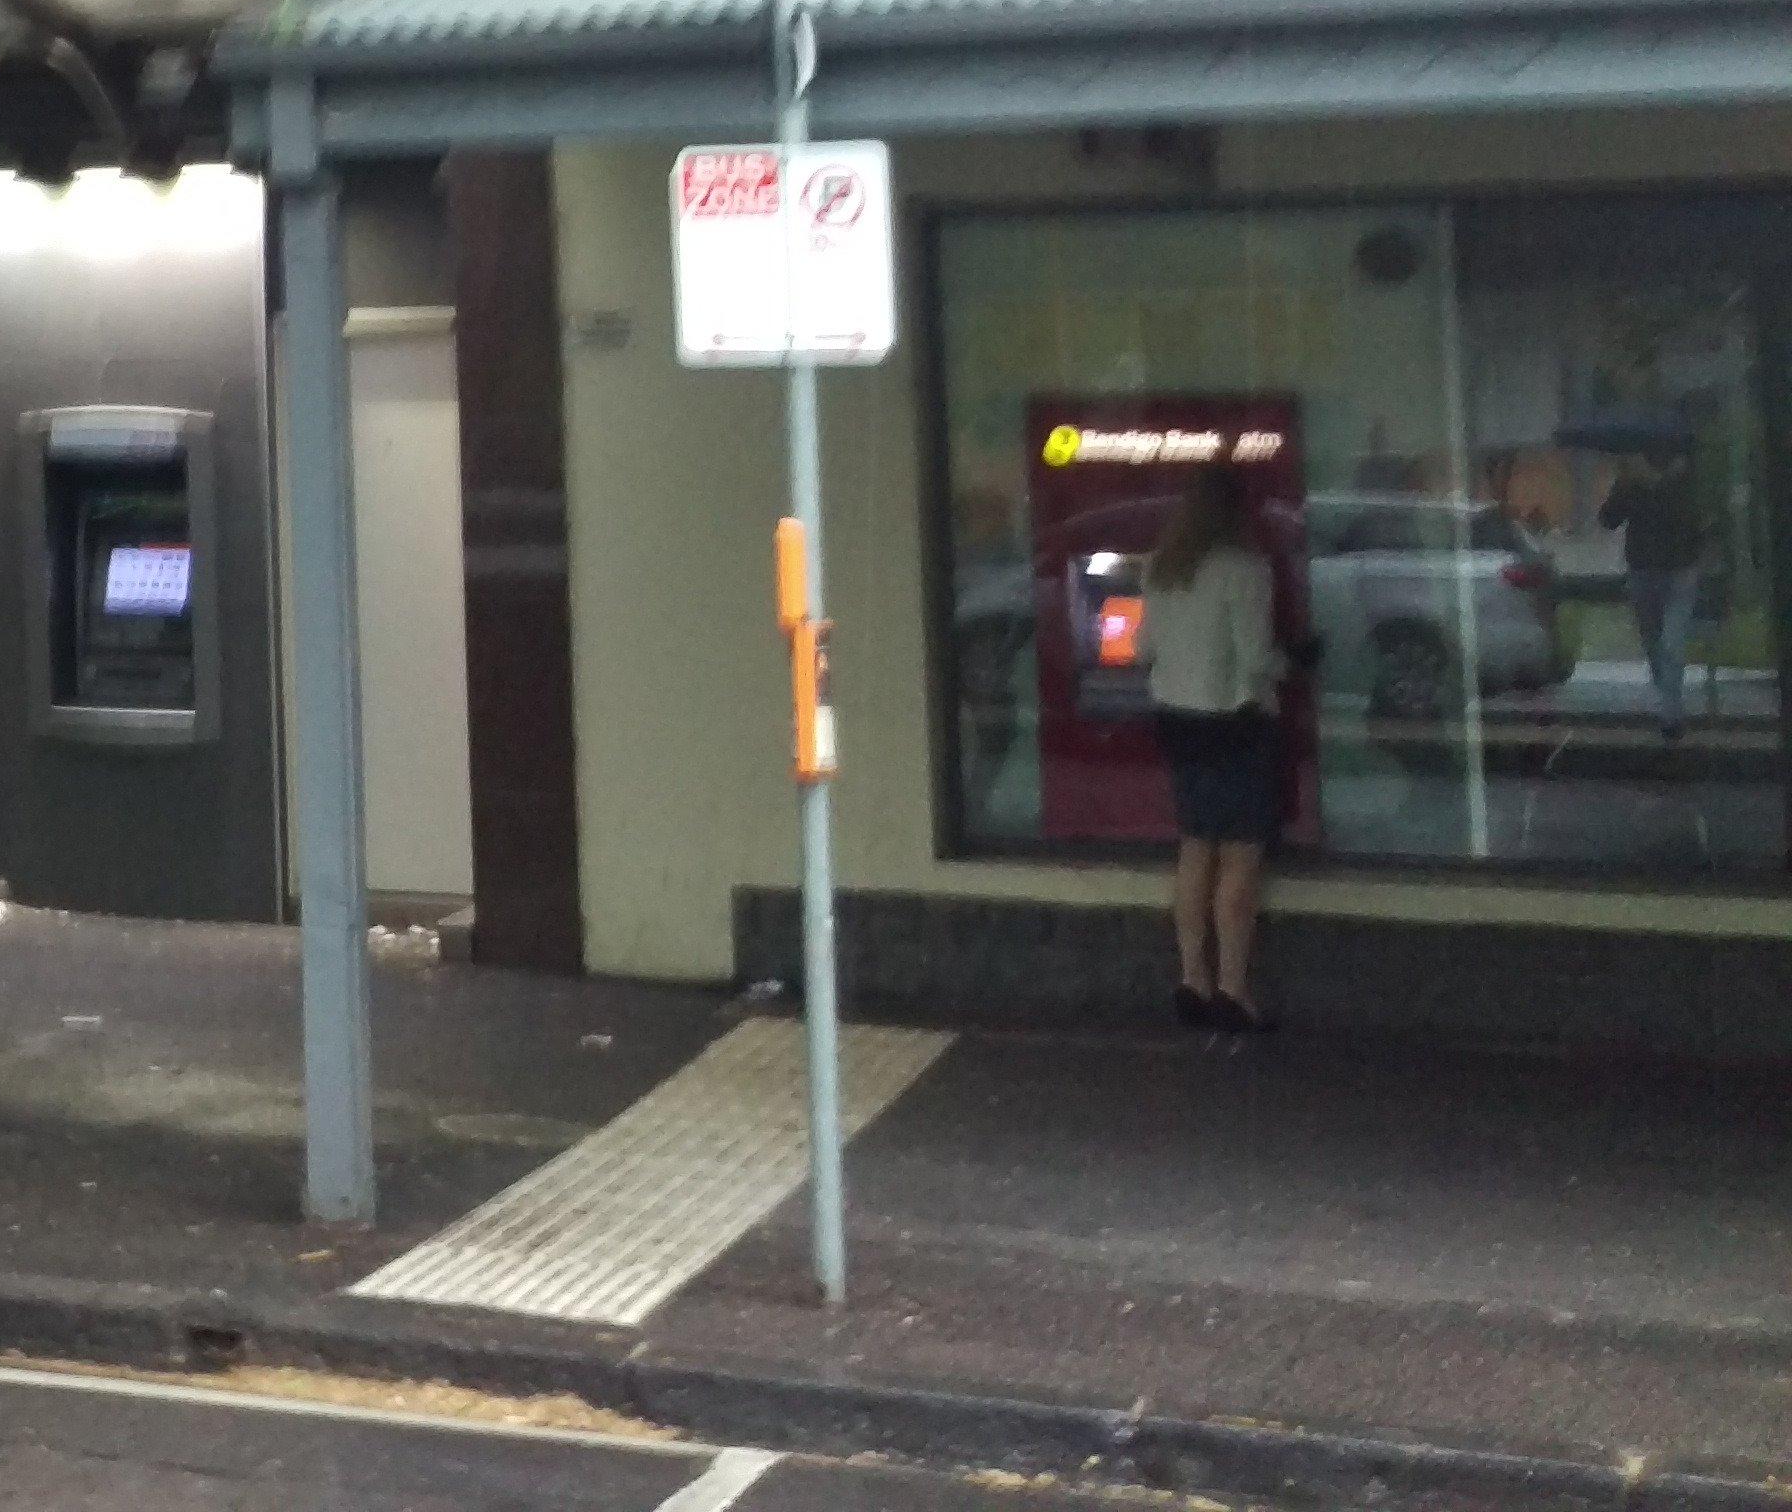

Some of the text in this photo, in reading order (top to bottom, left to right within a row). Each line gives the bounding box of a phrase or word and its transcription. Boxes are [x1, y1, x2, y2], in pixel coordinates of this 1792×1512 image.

[695, 154, 766, 181] BUS
[680, 179, 778, 217] ZONE
[1076, 429, 1165, 464] Bendigo
[1160, 428, 1220, 462] Bank
